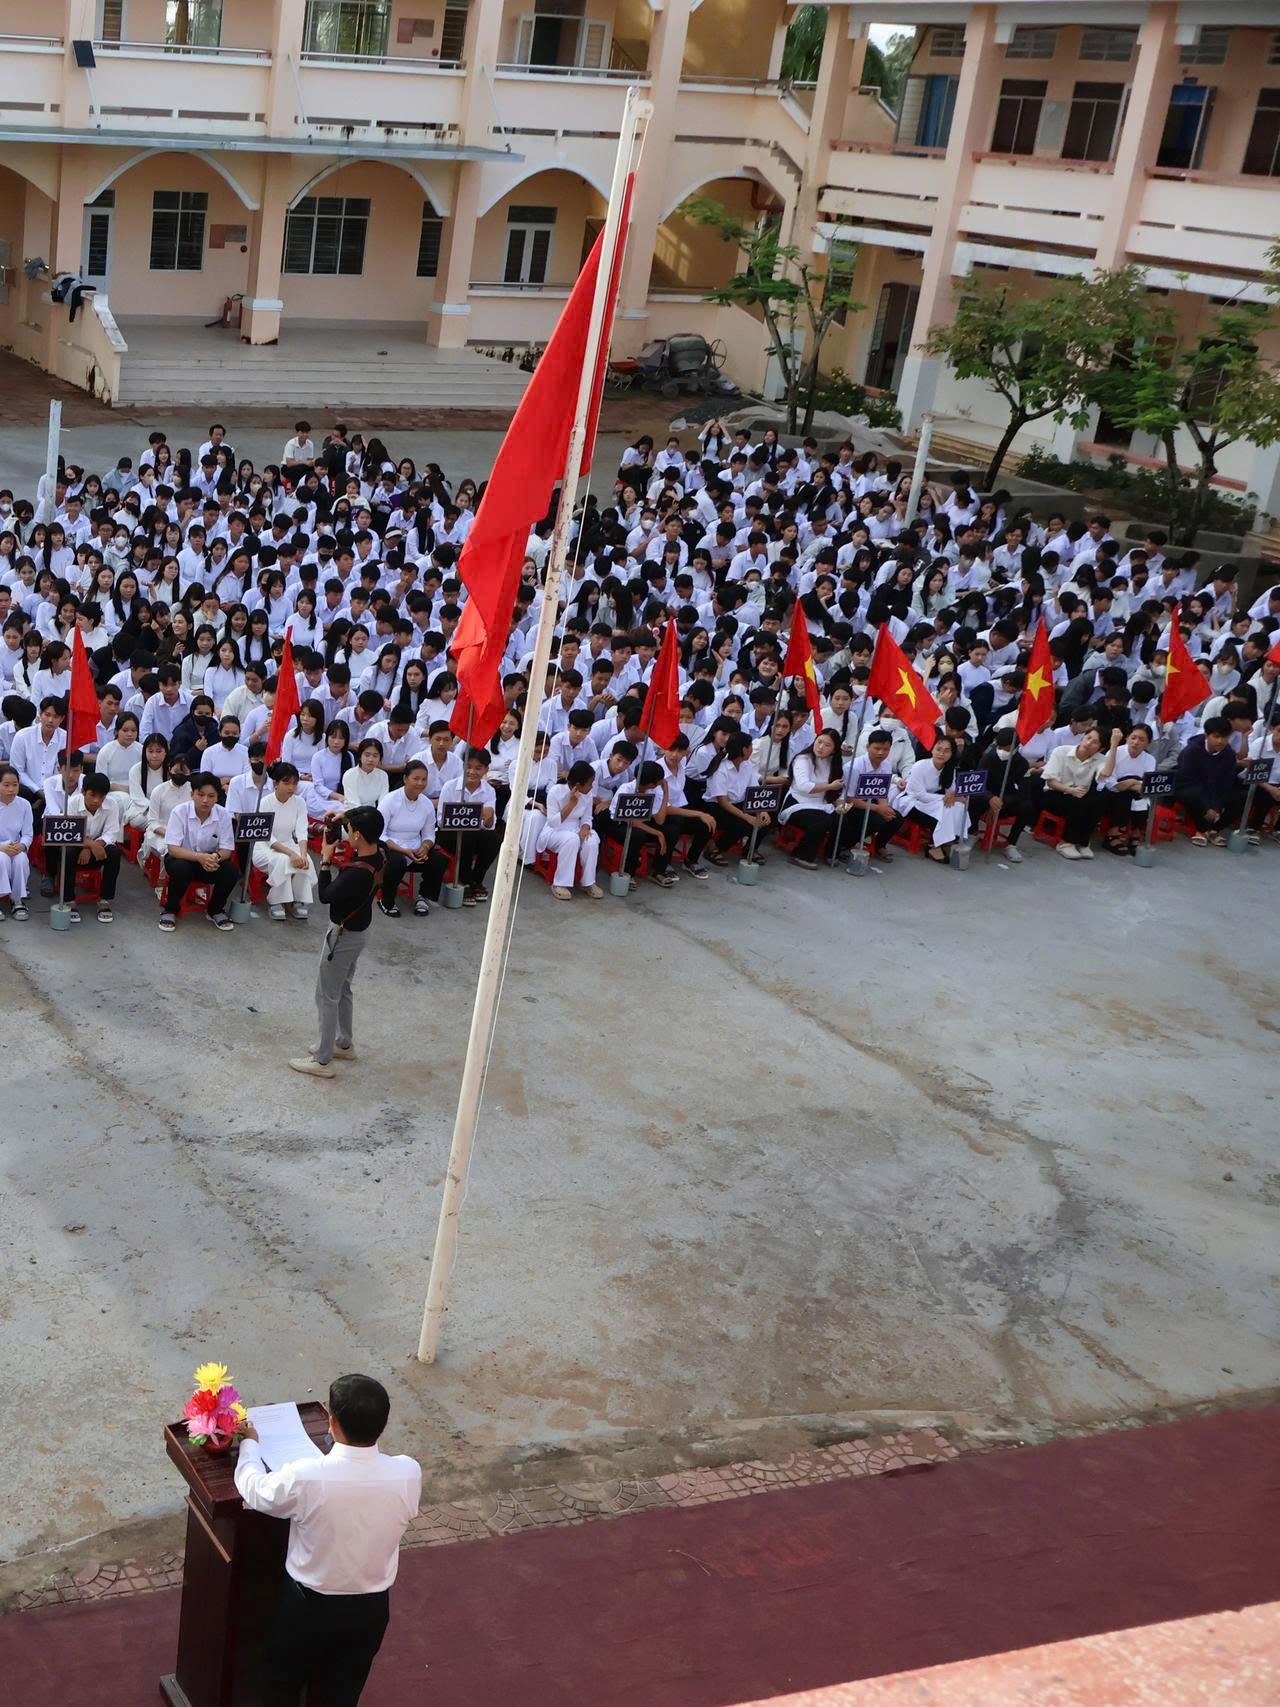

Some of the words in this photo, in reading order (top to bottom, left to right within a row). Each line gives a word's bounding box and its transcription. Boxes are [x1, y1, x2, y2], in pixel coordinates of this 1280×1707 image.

[865, 777, 884, 786] LỚP
[964, 774, 981, 783] LỚP
[857, 787, 889, 796] 10C9
[957, 783, 984, 793] 11C7
[753, 789, 773, 799] LỚP
[625, 797, 646, 807] LỚP
[746, 799, 777, 809] 10C8
[452, 806, 474, 816] LỚP
[617, 808, 650, 818] 10C7
[53, 819, 77, 830] LỚP
[246, 816, 266, 827] LỚP
[444, 817, 479, 827] 10C6
[45, 831, 82, 842] 10C4
[239, 828, 269, 838] 10C5
